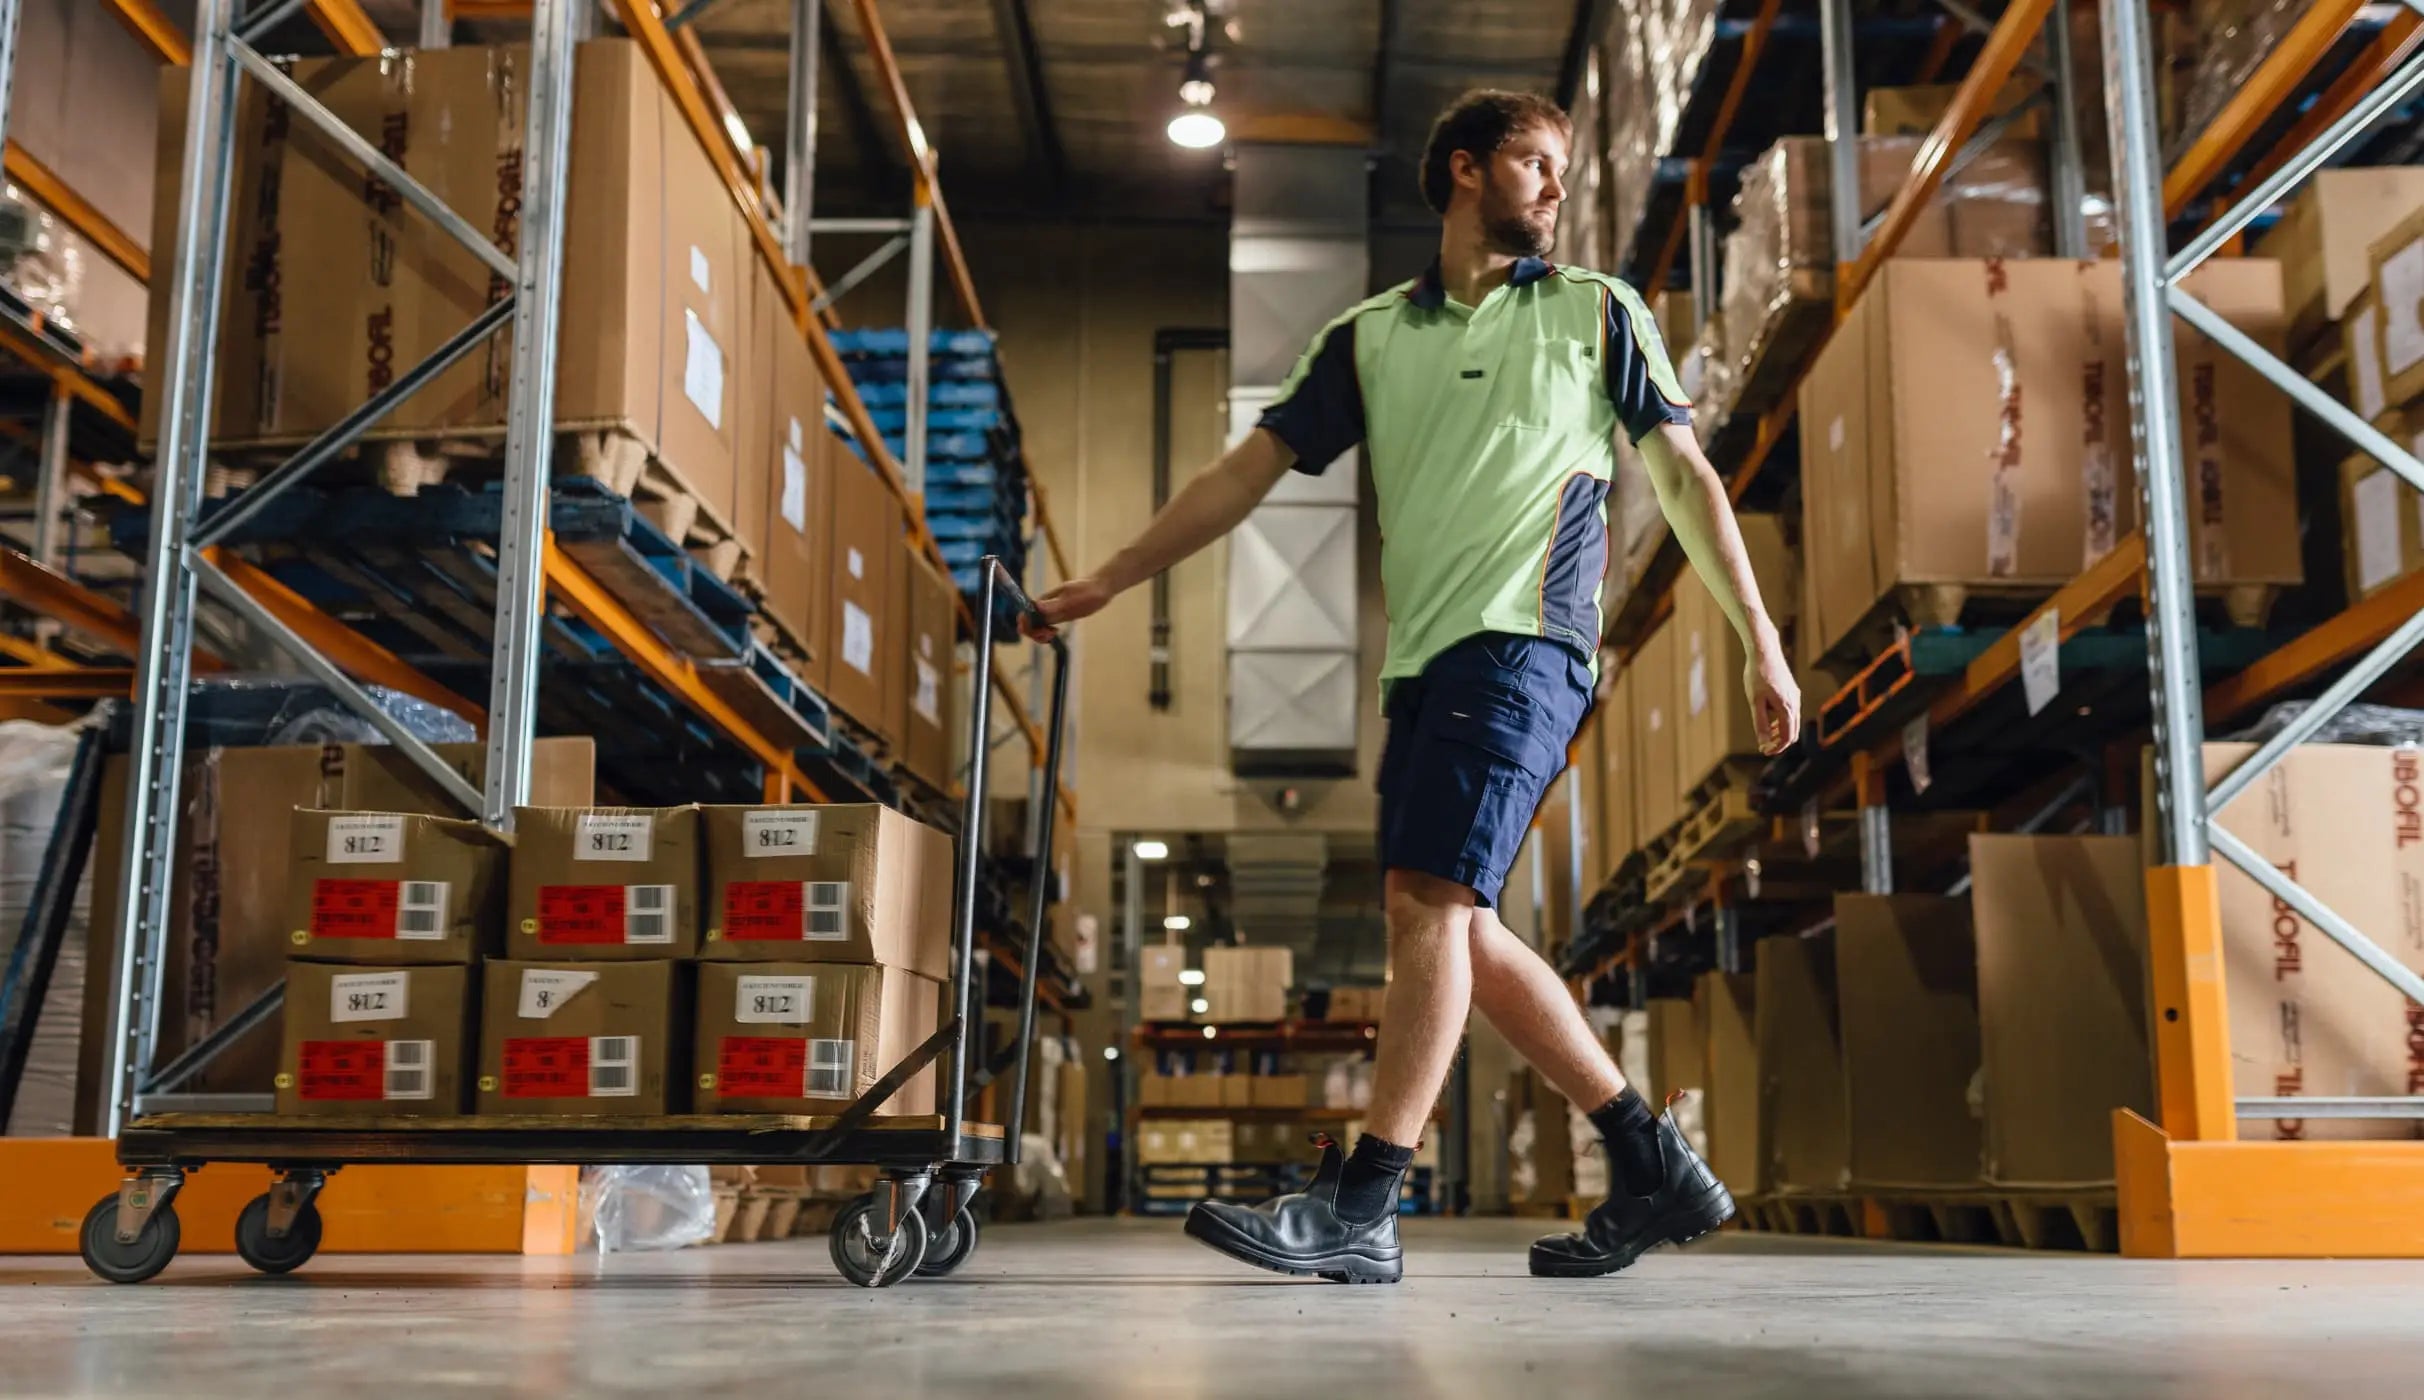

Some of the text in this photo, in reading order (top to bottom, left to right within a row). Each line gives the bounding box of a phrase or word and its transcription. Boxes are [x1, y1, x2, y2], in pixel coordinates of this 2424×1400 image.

[2393, 748, 2422, 849] UBOFIL
[344, 836, 383, 854] 812
[592, 833, 629, 851] 812
[760, 829, 794, 847] 812
[2273, 860, 2303, 983] TBOFIL
[348, 992, 387, 1010] 812
[537, 990, 554, 1008] 8
[754, 995, 790, 1013] 812
